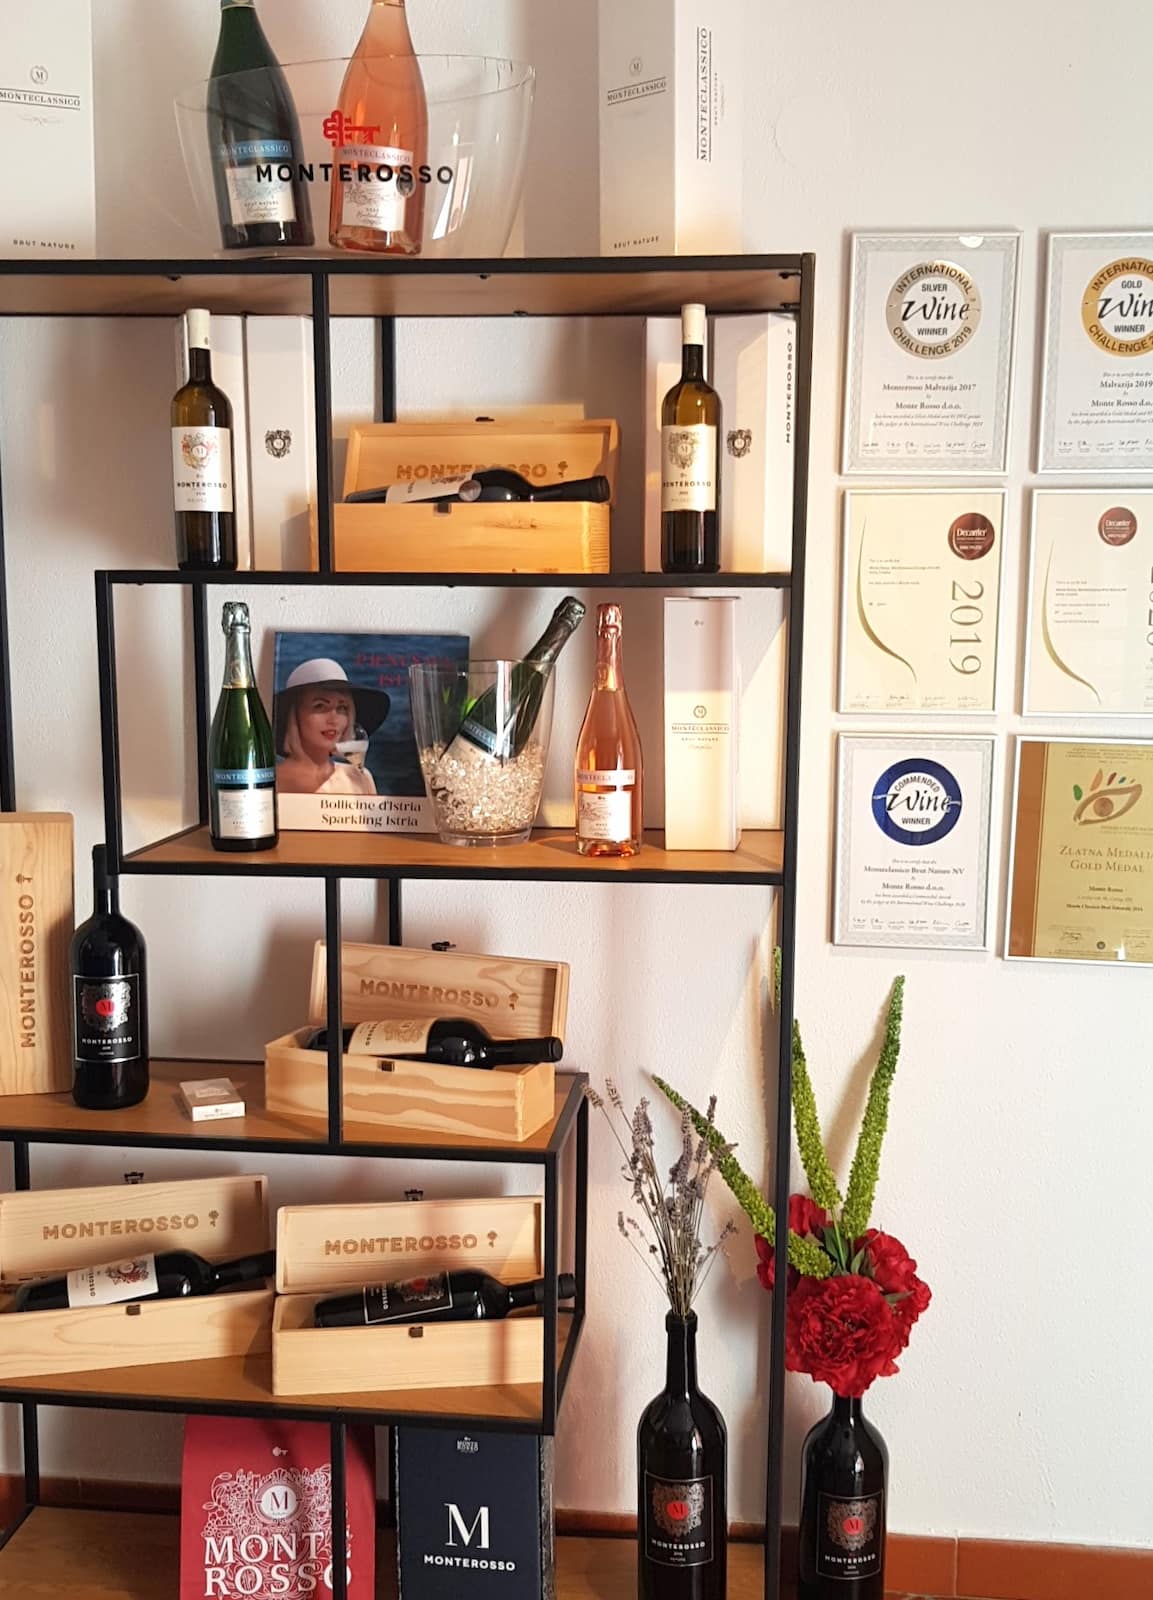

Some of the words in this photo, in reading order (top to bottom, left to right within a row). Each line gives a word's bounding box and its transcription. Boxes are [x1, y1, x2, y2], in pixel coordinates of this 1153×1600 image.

[700, 27, 709, 162] MONTECLASSICO
[256, 163, 454, 185] MONTEROSSO
[895, 263, 973, 294] INTERNATIONAL
[921, 283, 948, 293] SILVER
[1121, 279, 1143, 290] GOLD
[901, 295, 971, 322] Wine
[917, 327, 948, 337] WINNER
[1088, 324, 1149, 354] CHALLENGE
[1113, 323, 1146, 334] WINNER
[892, 326, 953, 356] CHALLENGE
[951, 325, 973, 348] 2019
[949, 580, 984, 675] 2019
[894, 775, 941, 793] COMMENDED
[320, 799, 375, 810] Bollicine
[378, 800, 422, 812] d'Istria
[884, 790, 952, 813] Wine
[321, 813, 383, 827] Sparkling
[386, 815, 419, 827] Istria
[901, 816, 931, 826] WINNER
[1070, 859, 1102, 870] GOLD
[18, 893, 36, 1049] MONTEROSSO
[360, 978, 500, 1009] MONTEROSSO
[81, 1036, 133, 1045] MONTEROSSO
[43, 1213, 200, 1240] MONTEROSSO
[324, 1233, 478, 1256] MONTEROSSO
[271, 1491, 289, 1511] M
[444, 1503, 490, 1549] M
[204, 1531, 351, 1566] MONT
[651, 1538, 706, 1550] MONTEROSSO
[424, 1554, 516, 1572] MONTEROSSO
[825, 1553, 876, 1564] MONTEROSSO
